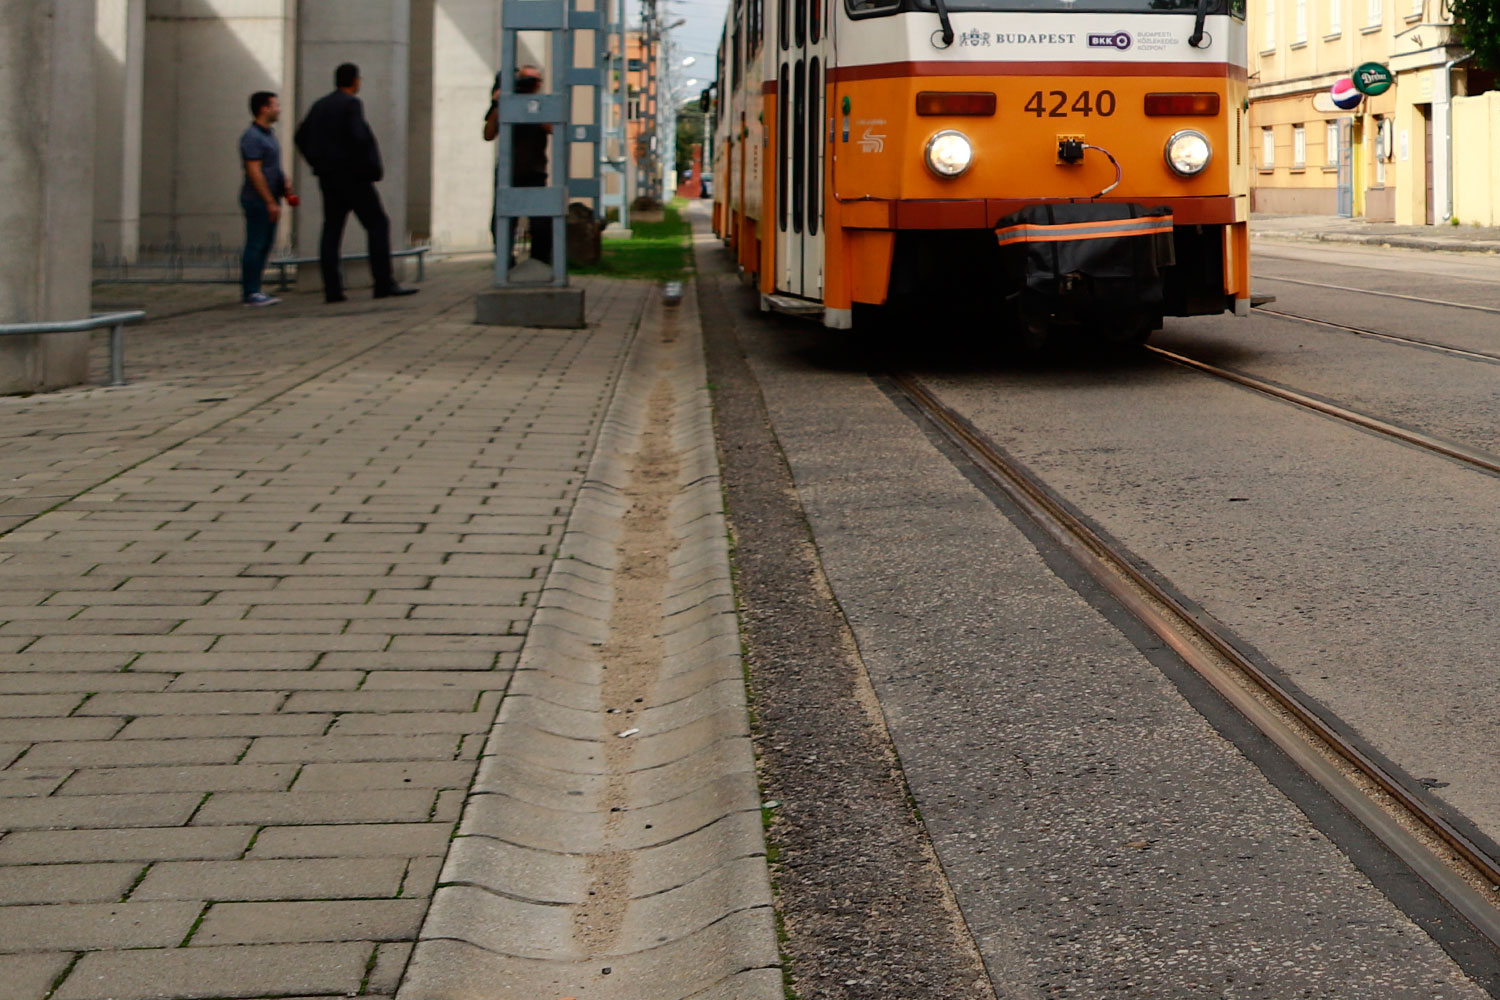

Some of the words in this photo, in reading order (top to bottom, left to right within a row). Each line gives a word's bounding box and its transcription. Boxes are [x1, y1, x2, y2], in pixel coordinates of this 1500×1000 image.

[996, 33, 1076, 44] BUDAPEST
[1092, 37, 1113, 45] BKK
[1024, 89, 1116, 118] 4240
